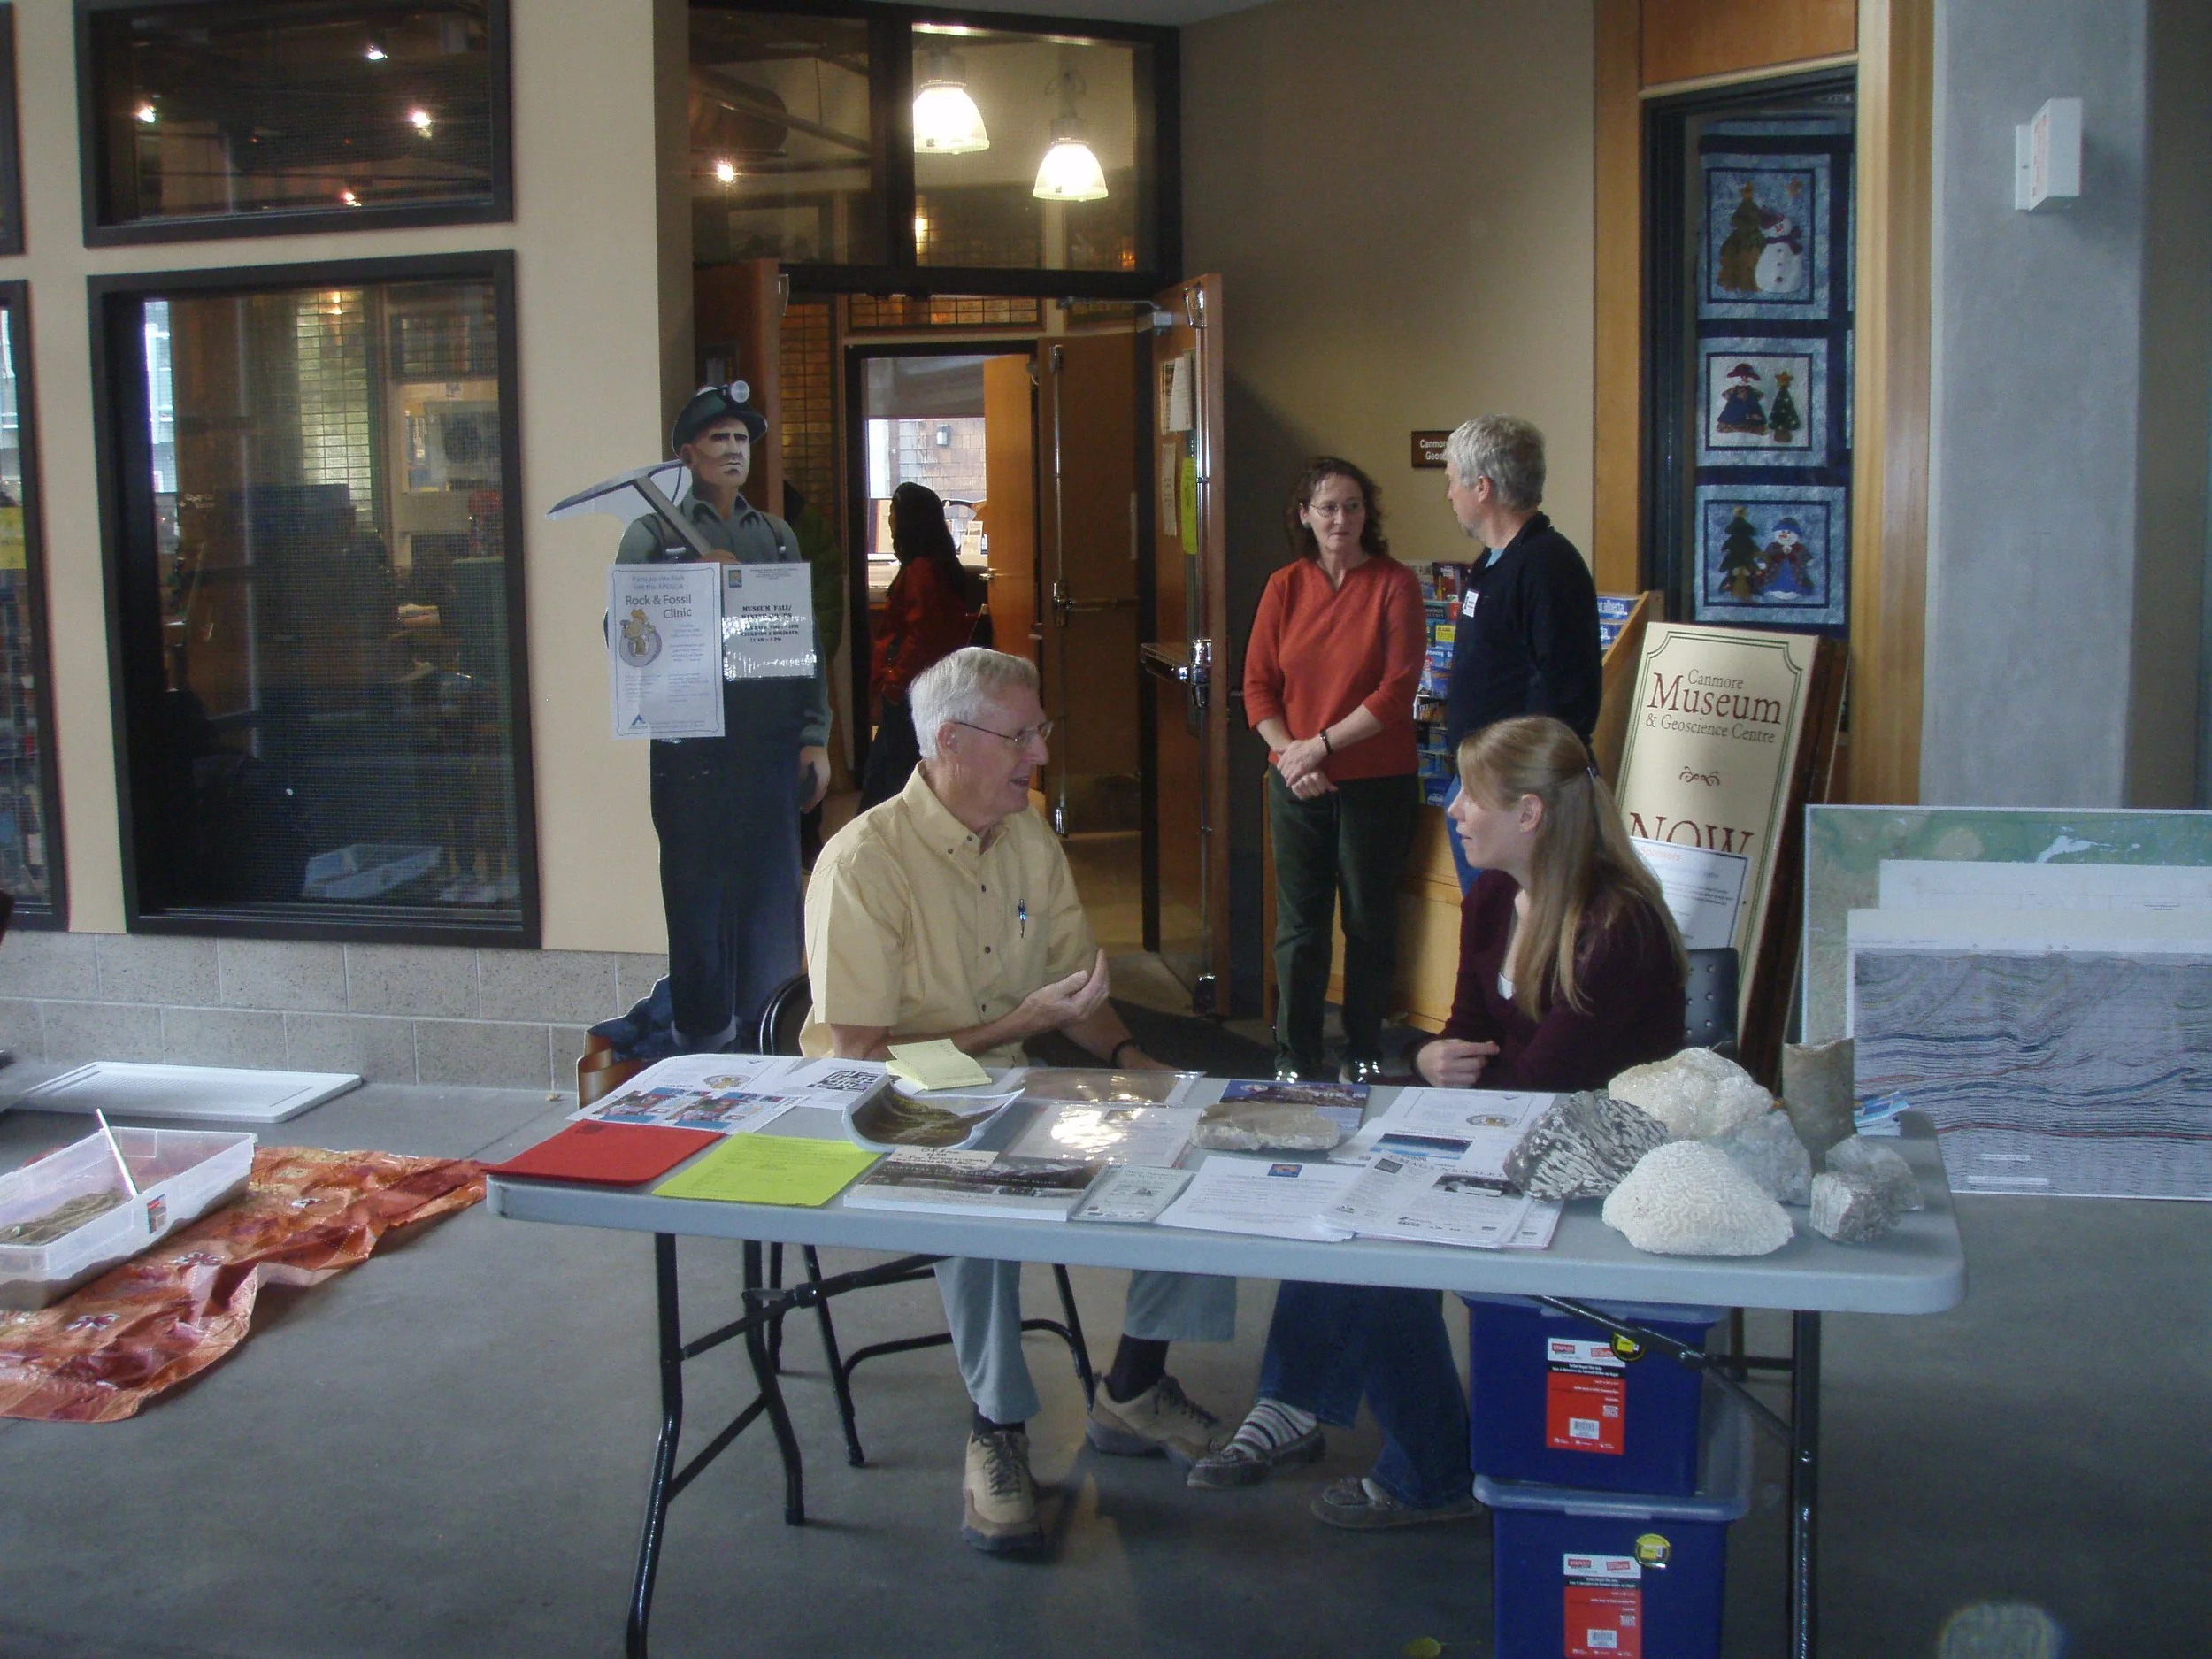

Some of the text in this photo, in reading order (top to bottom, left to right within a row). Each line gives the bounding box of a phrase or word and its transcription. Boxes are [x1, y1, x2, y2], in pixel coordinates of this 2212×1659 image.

[626, 594, 692, 605] Rock & Fossil
[664, 609, 692, 618] Clinic
[1688, 669, 1744, 689] Canmore
[1647, 672, 1781, 725] Museum
[1647, 713, 1775, 744] & Geoscience Centre
[1630, 812, 1755, 855] NOW
